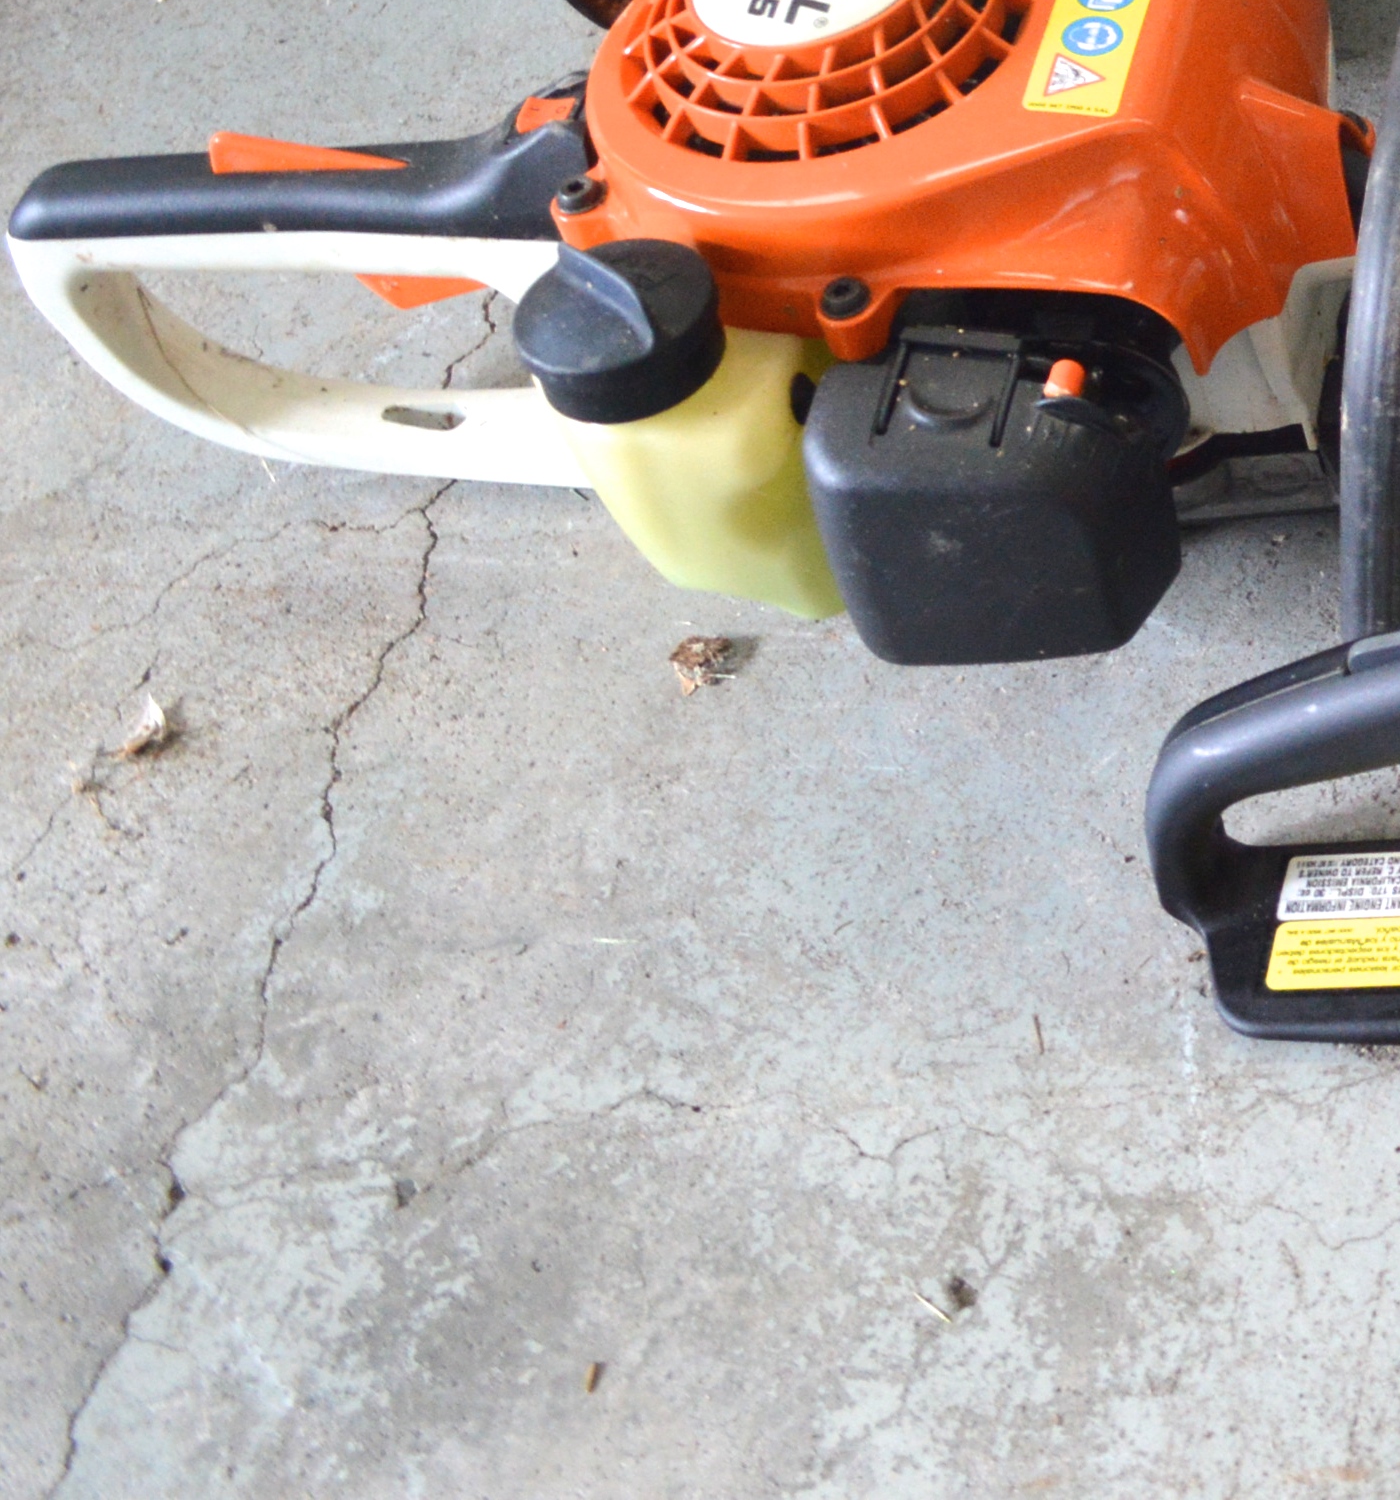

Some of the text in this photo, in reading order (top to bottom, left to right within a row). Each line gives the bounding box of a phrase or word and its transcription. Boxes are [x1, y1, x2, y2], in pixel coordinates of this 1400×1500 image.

[1339, 856, 1385, 867] CATEGORY
[1340, 868, 1352, 876] TO
[1354, 866, 1383, 876] REFER
[1305, 877, 1348, 888] EMISSION
[1283, 899, 1347, 913] INFORMATION
[1348, 898, 1383, 911] ENGINE
[1314, 937, 1361, 947] Manuales
[1274, 949, 1305, 957] deben
[1307, 946, 1372, 956] espectadores
[1301, 956, 1331, 965] riesgo
[1345, 955, 1378, 963] reducir
[1292, 966, 1346, 976] personales
[1348, 965, 1388, 973] lesiones
